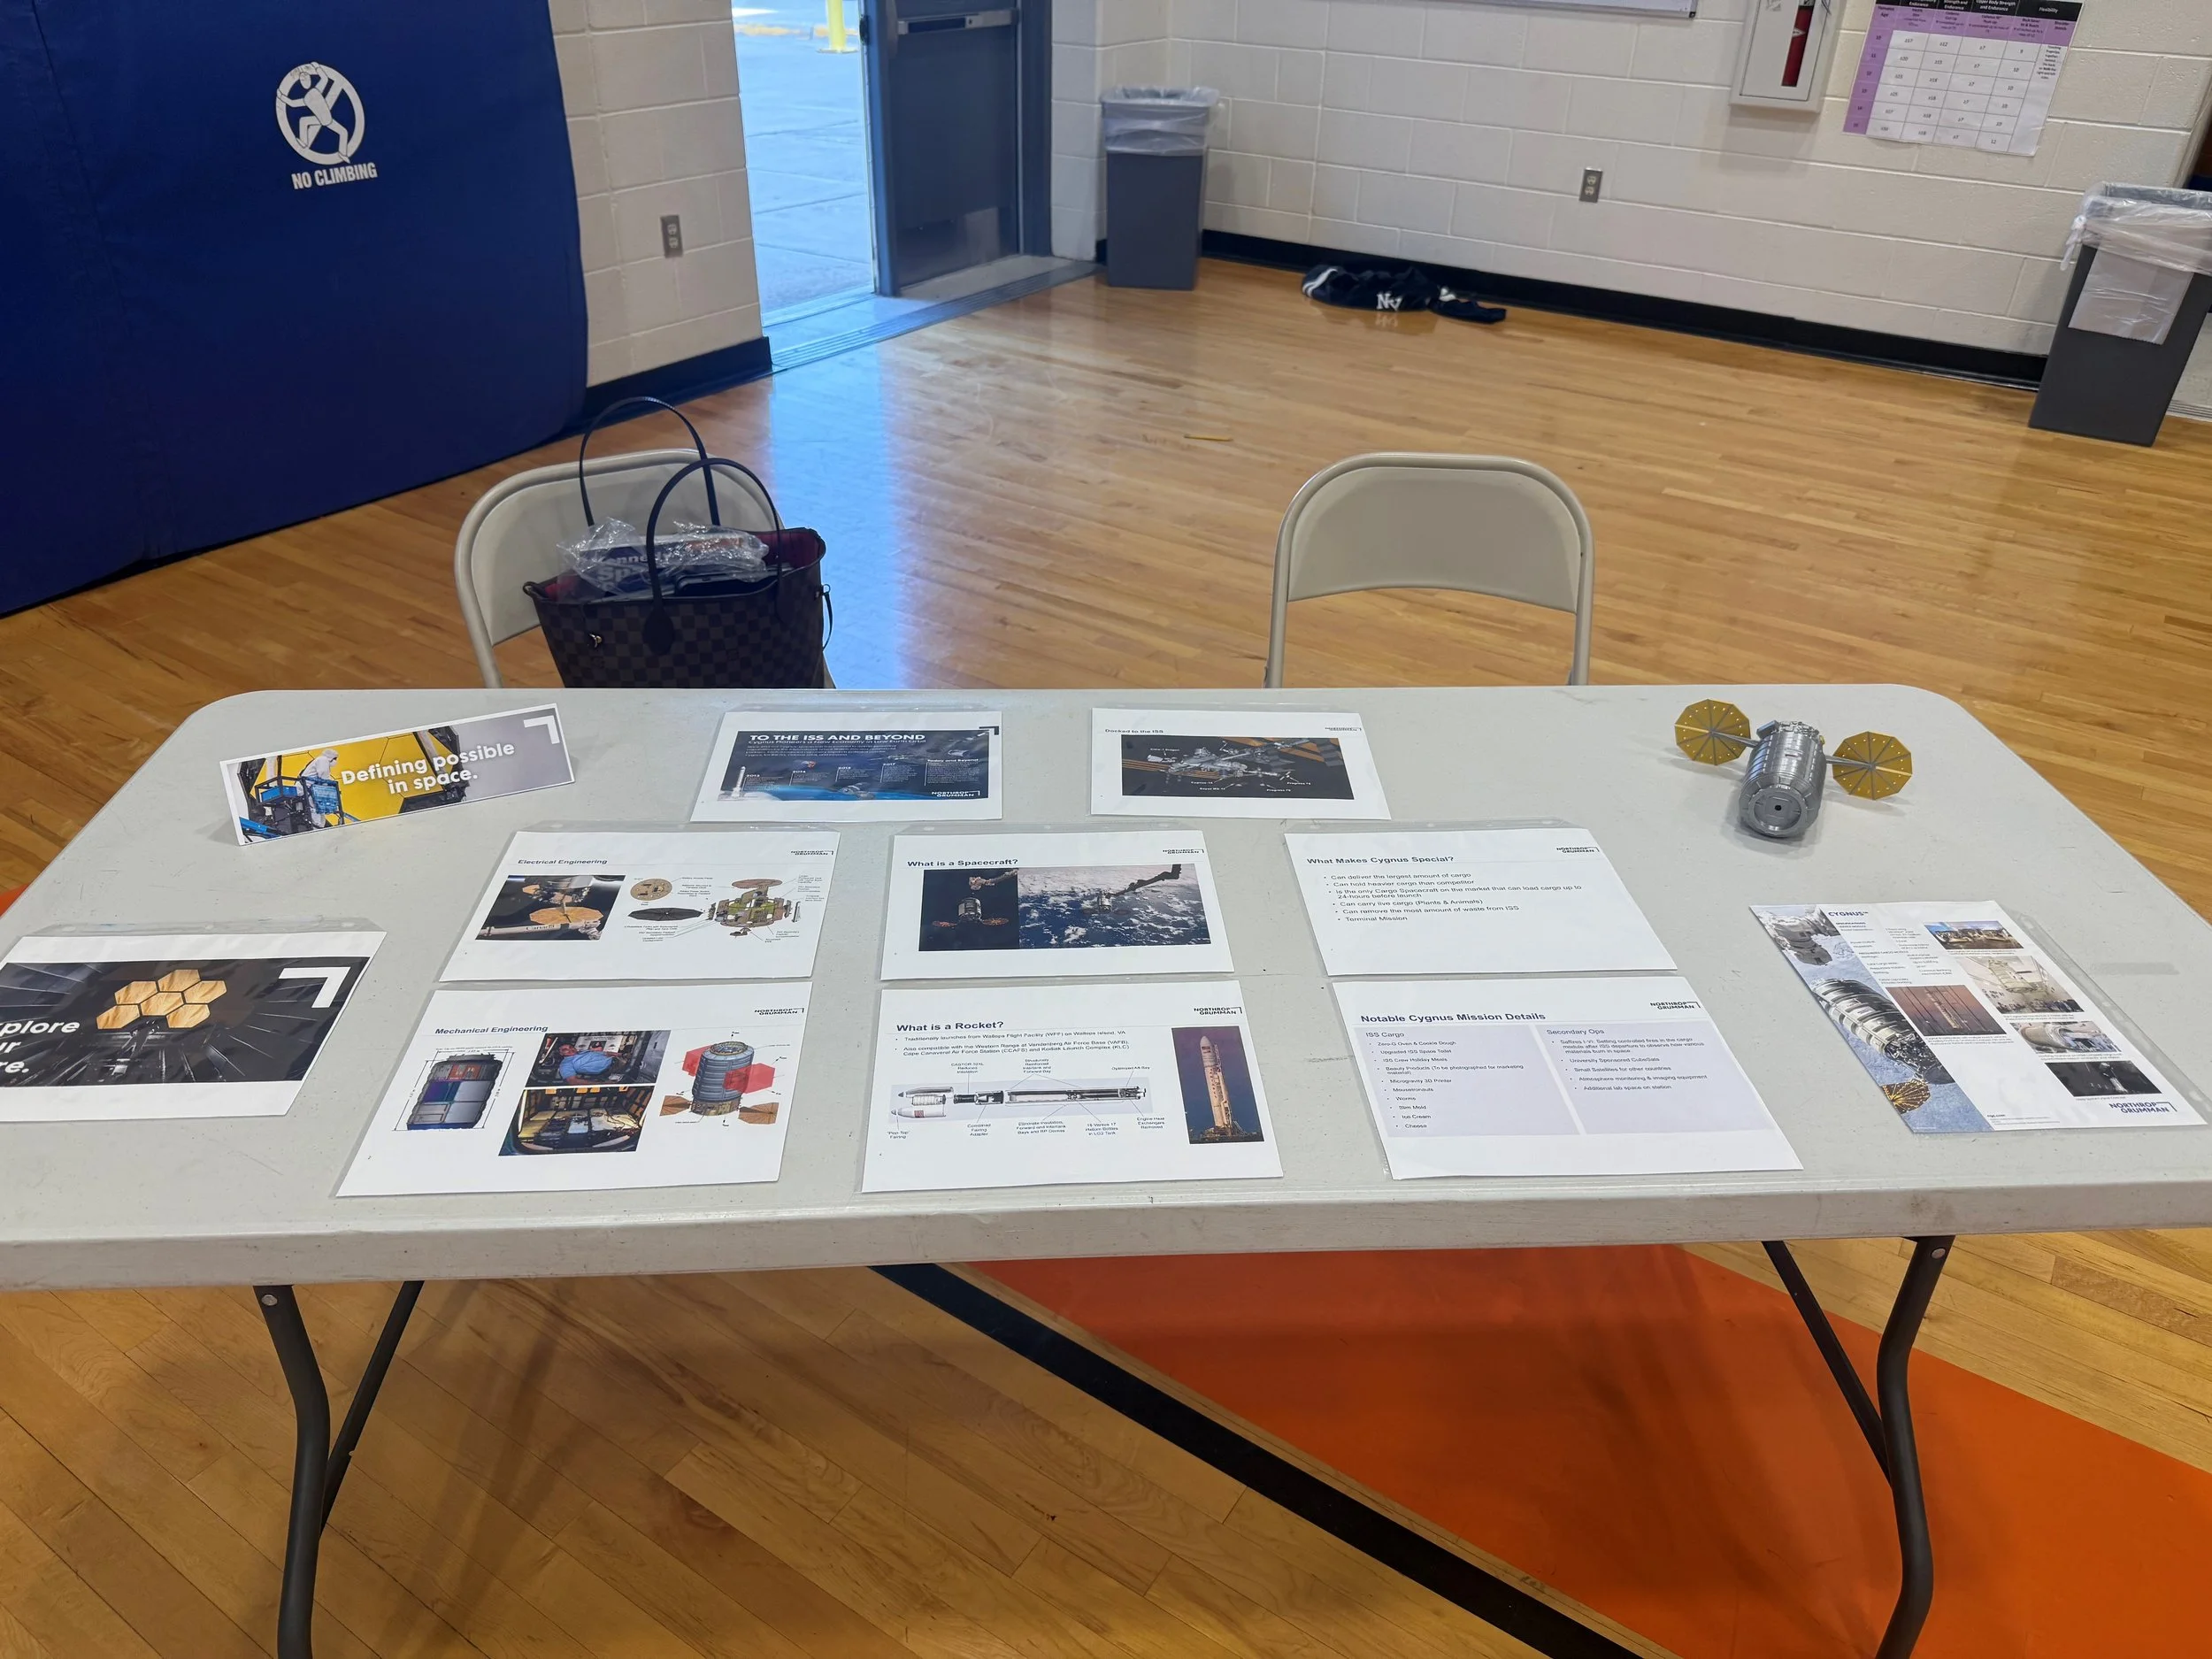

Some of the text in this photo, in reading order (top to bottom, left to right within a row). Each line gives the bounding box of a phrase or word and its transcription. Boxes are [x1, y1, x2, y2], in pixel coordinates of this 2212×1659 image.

[291, 162, 378, 189] NO CLIMBING
[341, 742, 515, 785] Defining possible
[388, 769, 478, 795] in space.
[0, 1020, 81, 1037] plore
